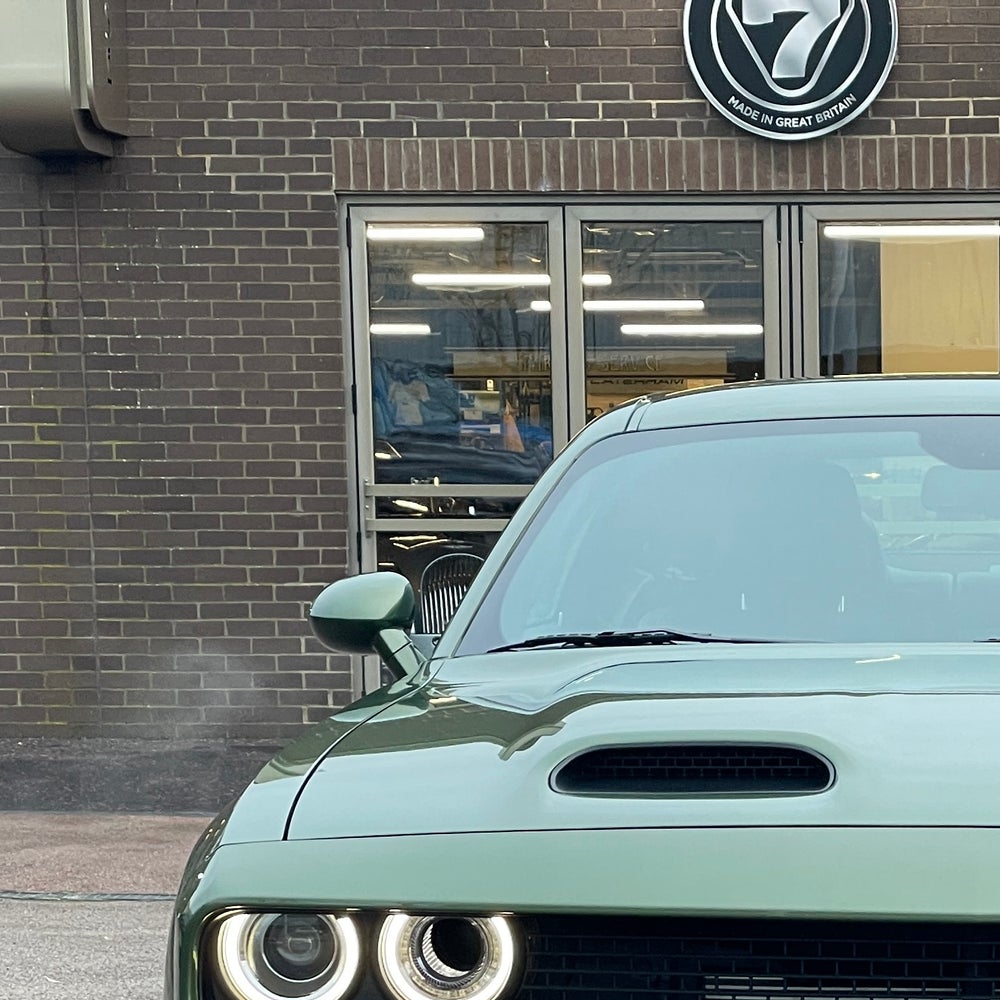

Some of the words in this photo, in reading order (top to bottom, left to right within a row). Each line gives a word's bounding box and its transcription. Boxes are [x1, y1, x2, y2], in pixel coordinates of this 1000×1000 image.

[742, 0, 841, 78] 7
[727, 95, 759, 121] MADE
[760, 112, 774, 126] IN
[775, 114, 814, 128] GREAT
[815, 93, 858, 124] BRITAIN
